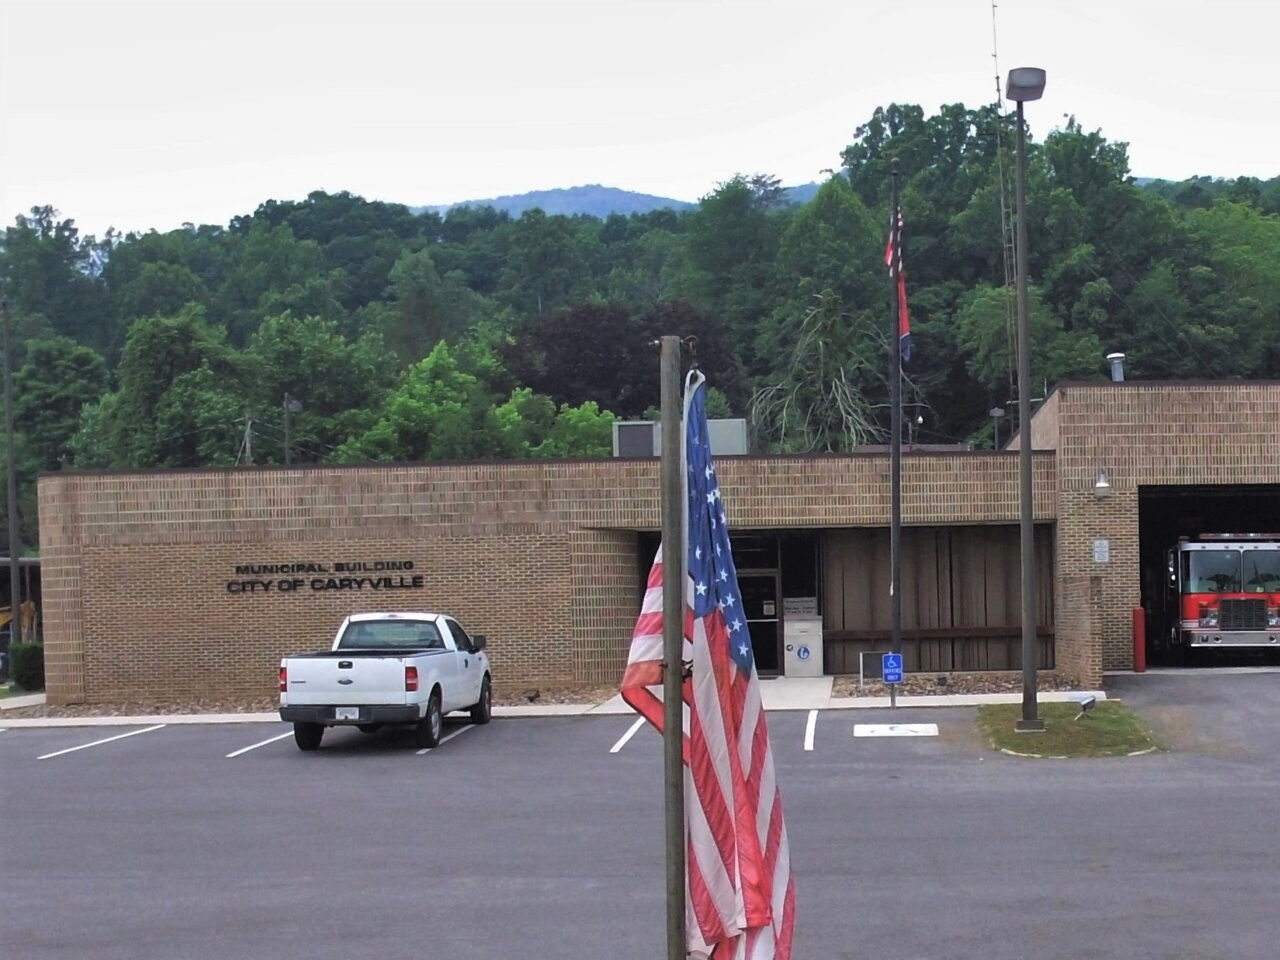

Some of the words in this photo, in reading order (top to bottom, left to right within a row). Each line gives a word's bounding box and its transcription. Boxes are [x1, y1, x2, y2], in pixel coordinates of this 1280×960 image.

[235, 564, 329, 575] MUNICIPAL
[334, 561, 414, 572] BUILDING
[227, 580, 273, 593] CITY
[277, 579, 304, 591] OF
[310, 576, 424, 591] CARYVILLE
